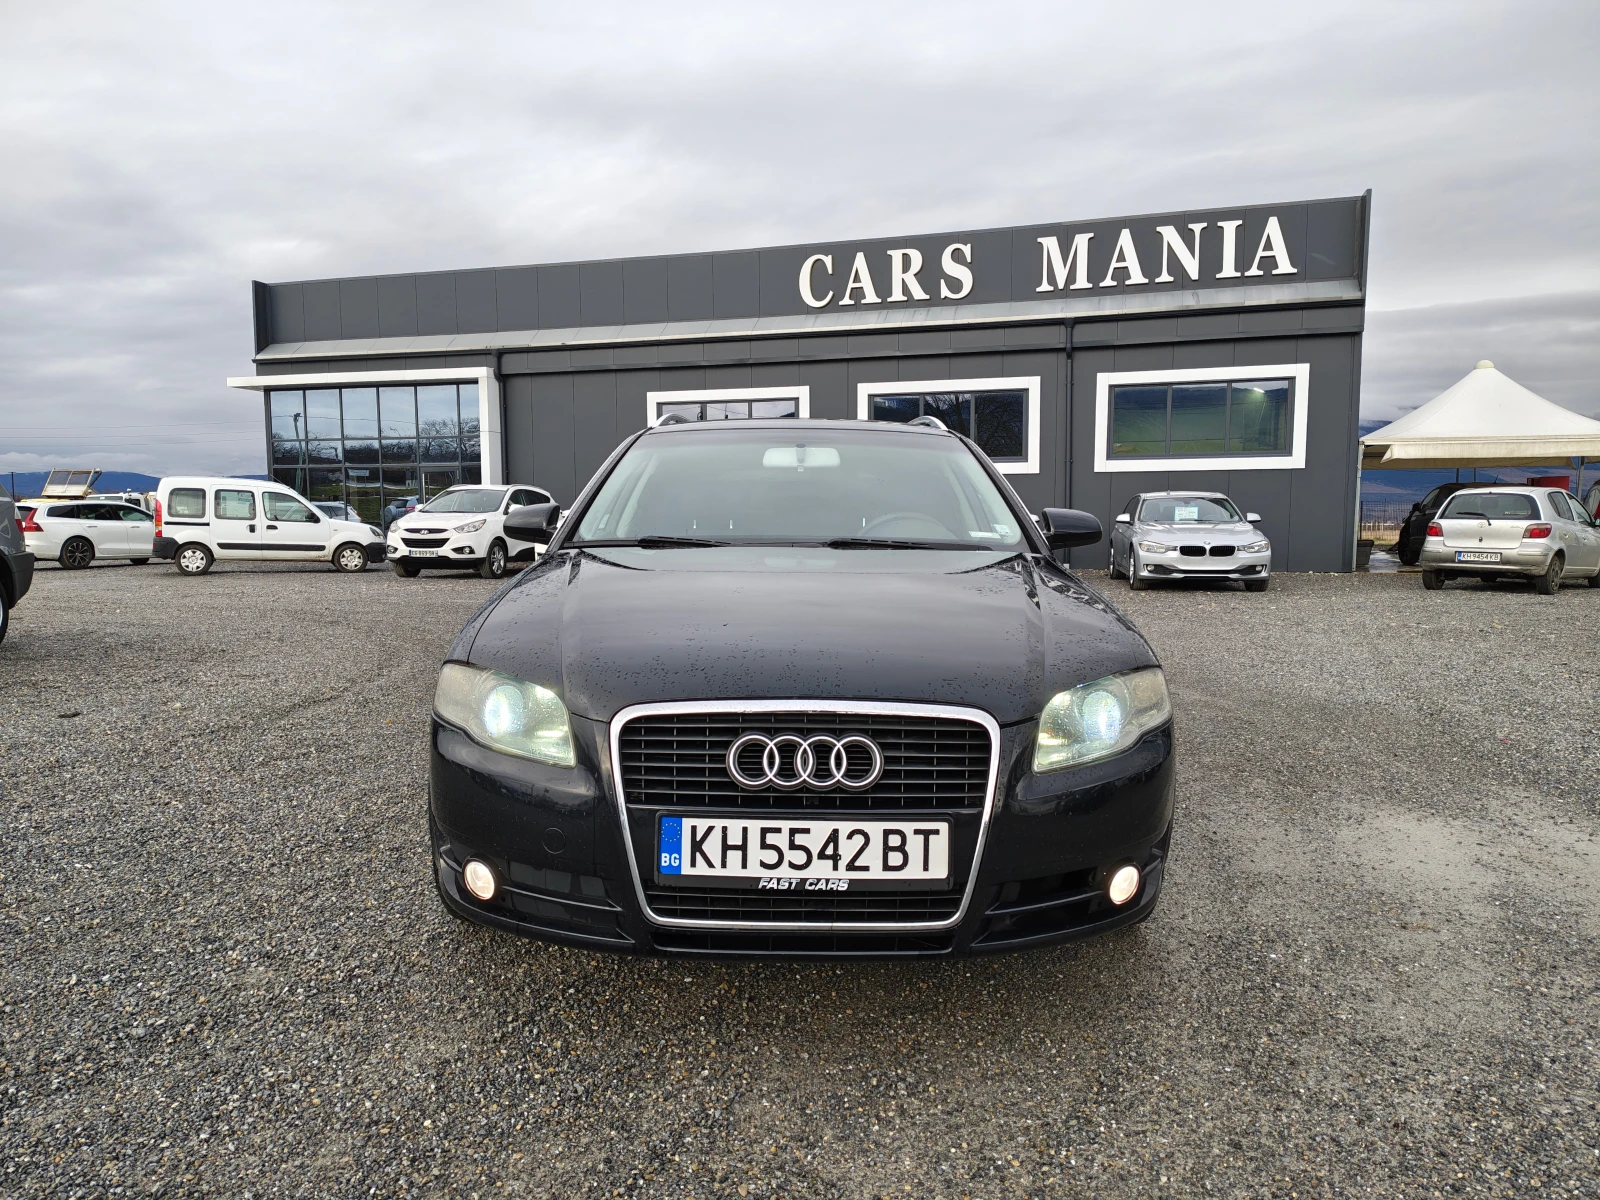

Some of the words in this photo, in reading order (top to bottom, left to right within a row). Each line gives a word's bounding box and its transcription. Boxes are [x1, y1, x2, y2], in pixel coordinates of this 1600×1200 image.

[798, 243, 974, 308] CARS
[1035, 216, 1298, 293] MANIA
[661, 852, 680, 867] BG
[758, 877, 801, 890] FAST
[804, 878, 850, 891] CARS
